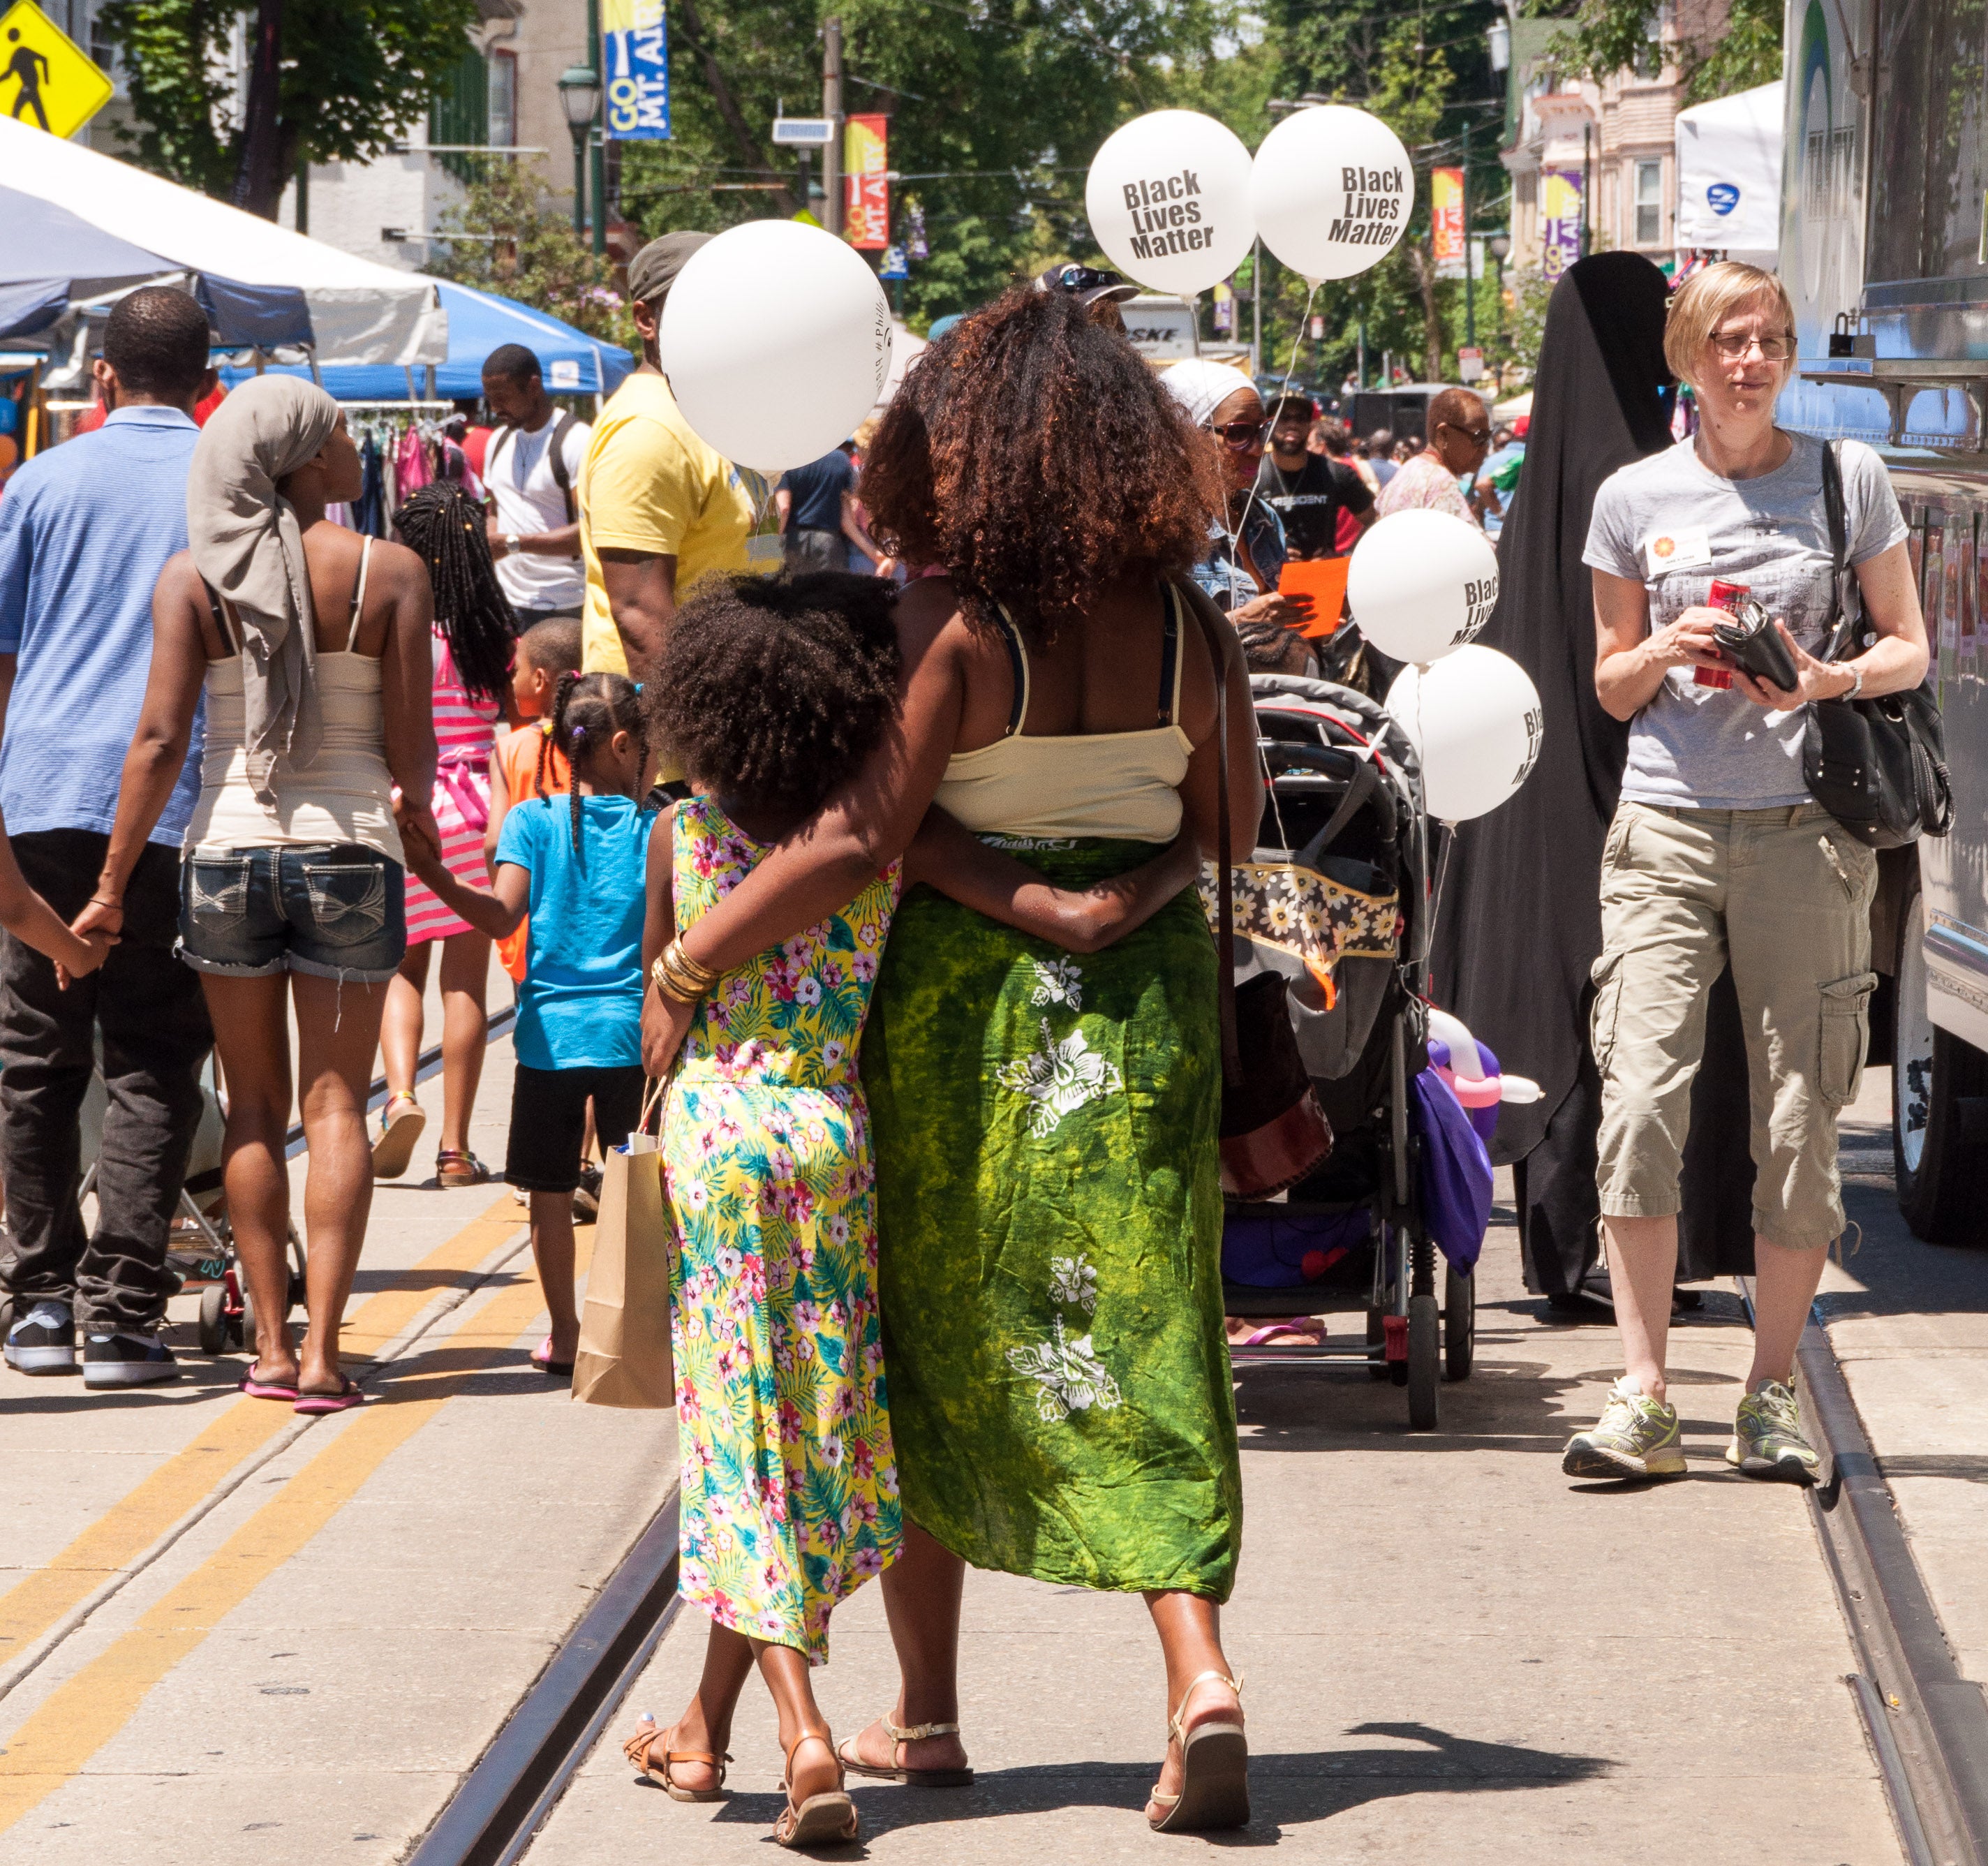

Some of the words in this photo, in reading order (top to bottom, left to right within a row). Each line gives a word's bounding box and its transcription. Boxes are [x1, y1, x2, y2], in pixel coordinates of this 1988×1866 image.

[633, 0, 666, 66] AIR
[609, 77, 638, 131] GO
[635, 72, 667, 129] MT.
[863, 141, 886, 200] AIRY
[1342, 166, 1403, 193] Black
[1122, 169, 1201, 210] Black
[1344, 193, 1400, 220] Lives
[847, 205, 867, 242] GO
[865, 203, 886, 242] MT.
[1131, 201, 1201, 235] Lives
[1328, 219, 1399, 245] Matter
[1129, 225, 1214, 260] Matter
[1545, 245, 1562, 276] GO
